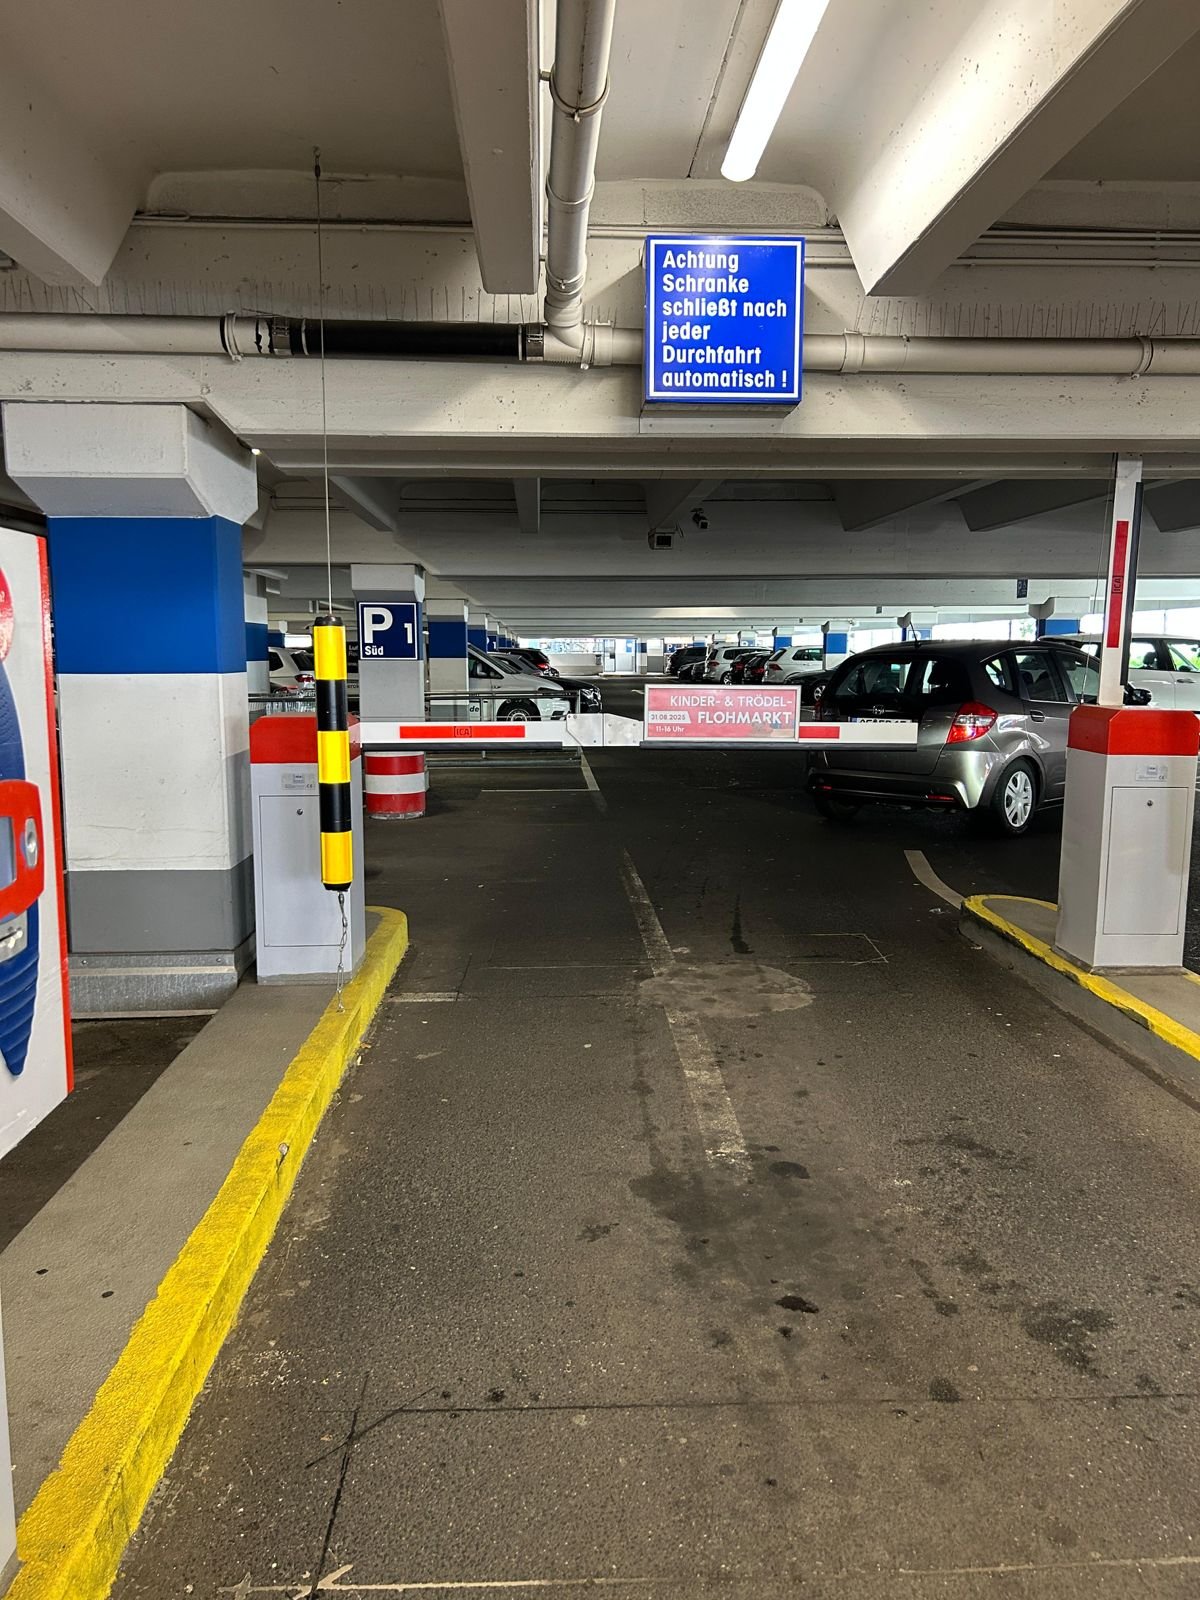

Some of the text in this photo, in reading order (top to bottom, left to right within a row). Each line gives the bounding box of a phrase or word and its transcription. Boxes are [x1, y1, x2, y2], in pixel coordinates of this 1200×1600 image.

[663, 250, 738, 272] Achtung
[663, 274, 749, 293] Schranke
[662, 298, 787, 317] schließt nach
[662, 321, 711, 343] jeder
[662, 345, 761, 364] Durchfahrt
[662, 369, 775, 387] automatisch
[364, 607, 413, 644] P 1
[365, 645, 384, 656] Süd
[670, 693, 793, 707] KINDER- & TRÖDEL-
[698, 711, 793, 724] FLOHMARKT
[672, 725, 685, 733] Uhr
